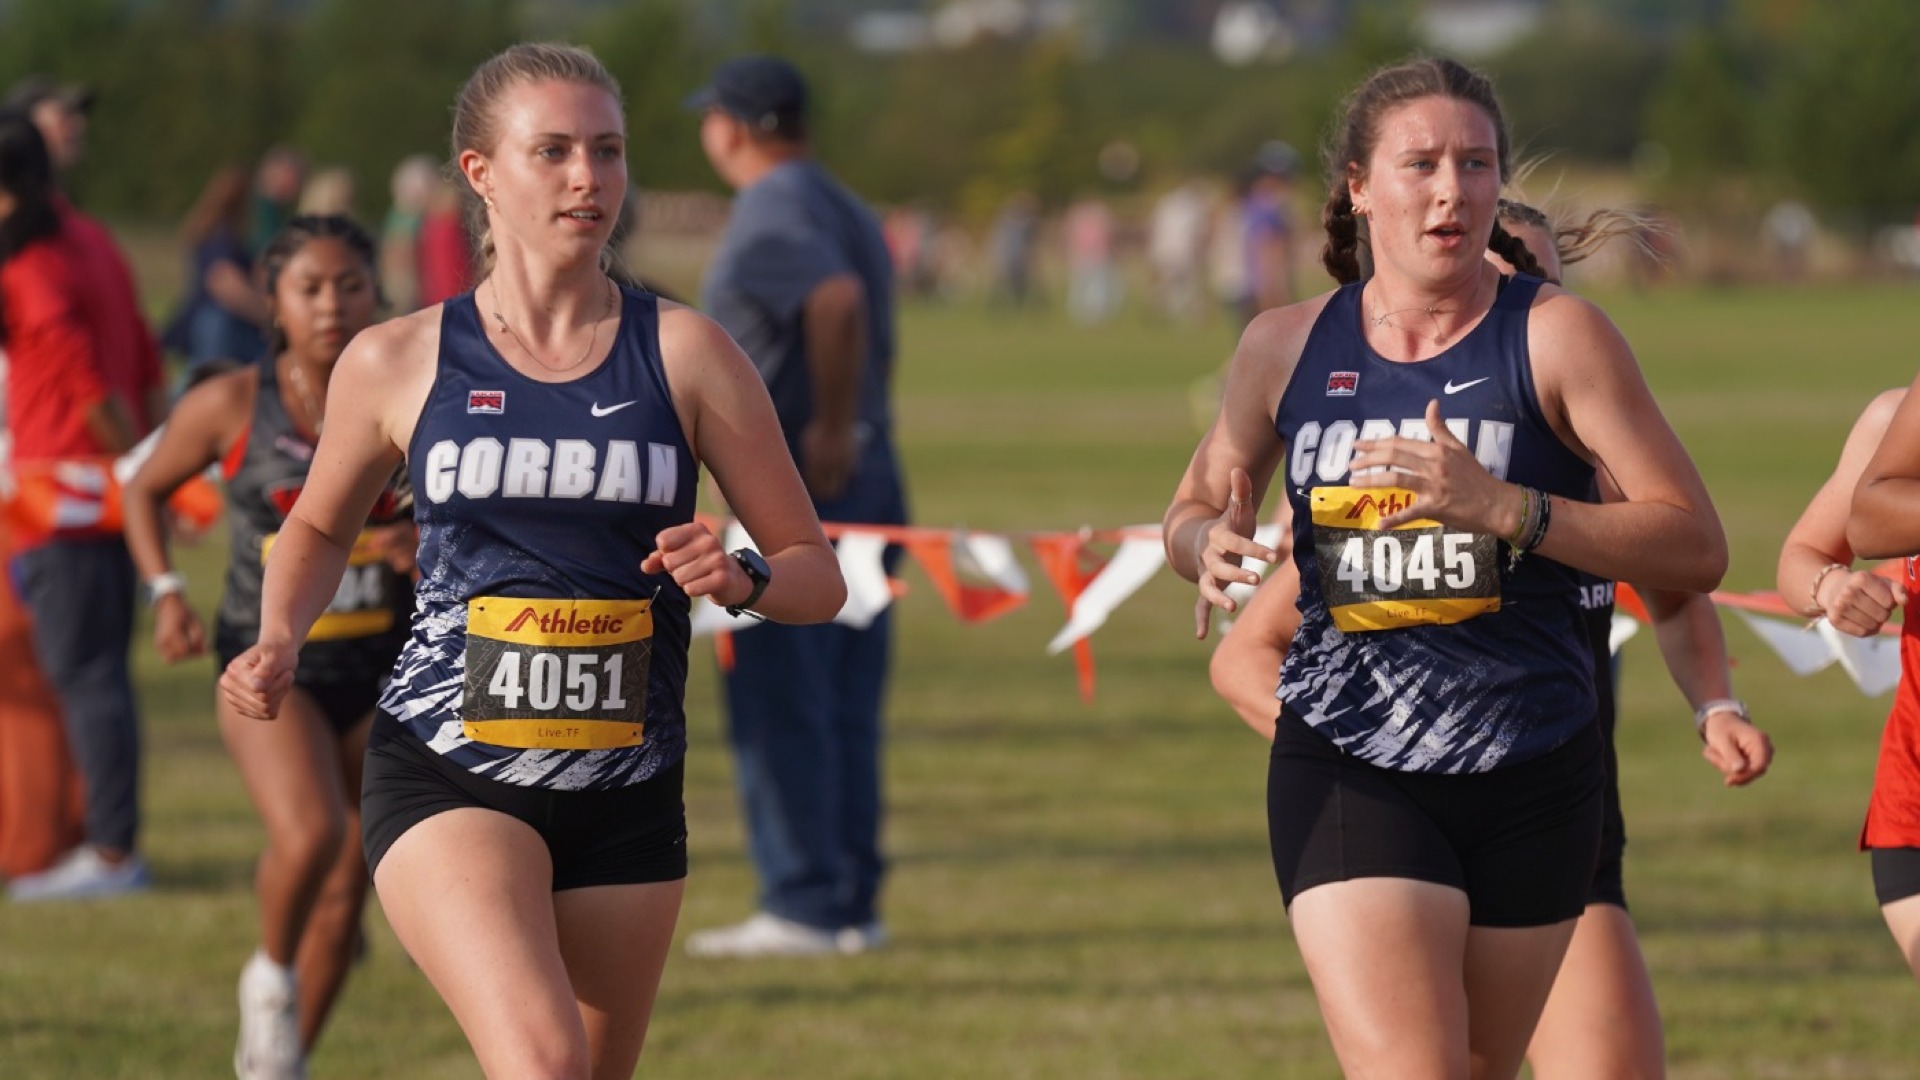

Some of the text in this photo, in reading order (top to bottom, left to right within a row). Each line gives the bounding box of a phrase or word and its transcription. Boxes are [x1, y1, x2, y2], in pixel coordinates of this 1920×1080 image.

[425, 437, 678, 507] CORBAN
[1345, 493, 1412, 520] Athl
[1336, 533, 1476, 593] 4045
[504, 606, 623, 635] Athletic
[488, 651, 627, 711] 4051
